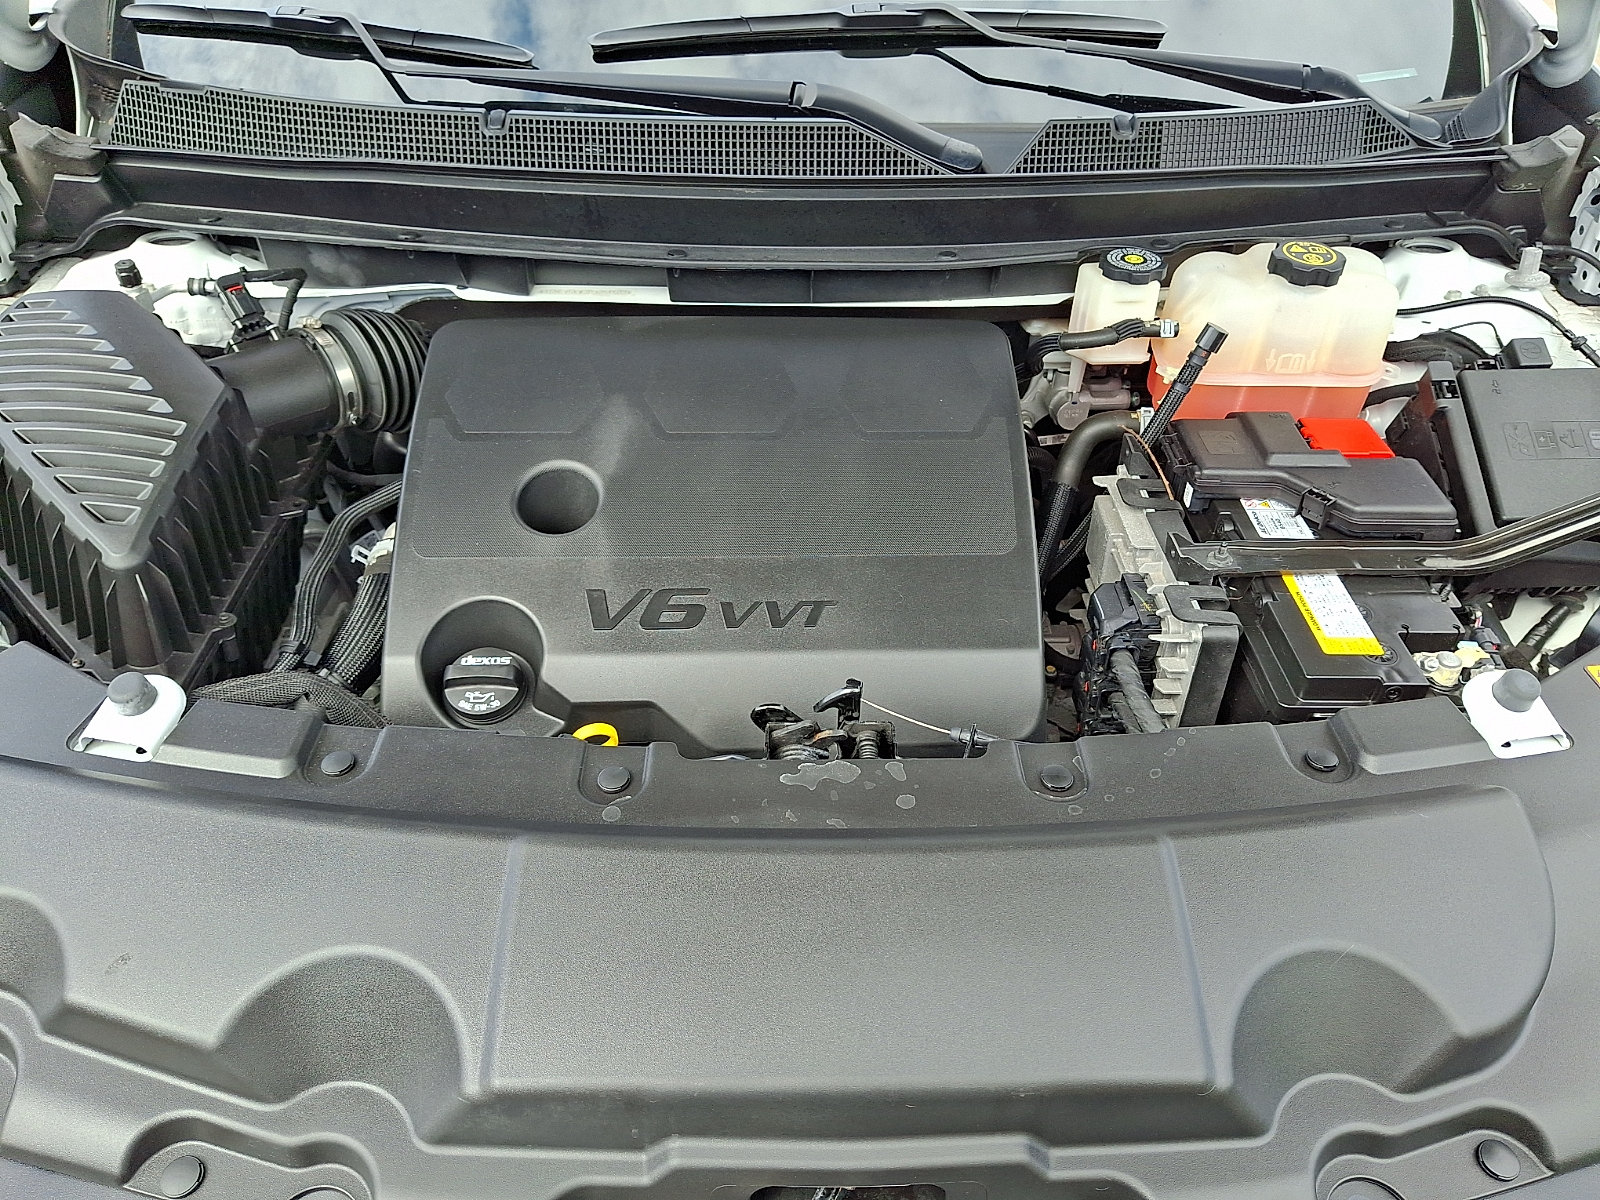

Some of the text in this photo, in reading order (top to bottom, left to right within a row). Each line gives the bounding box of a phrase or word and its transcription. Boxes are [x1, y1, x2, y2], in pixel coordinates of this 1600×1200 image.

[585, 587, 839, 630] V6 VVT
[460, 654, 513, 666] dexos
